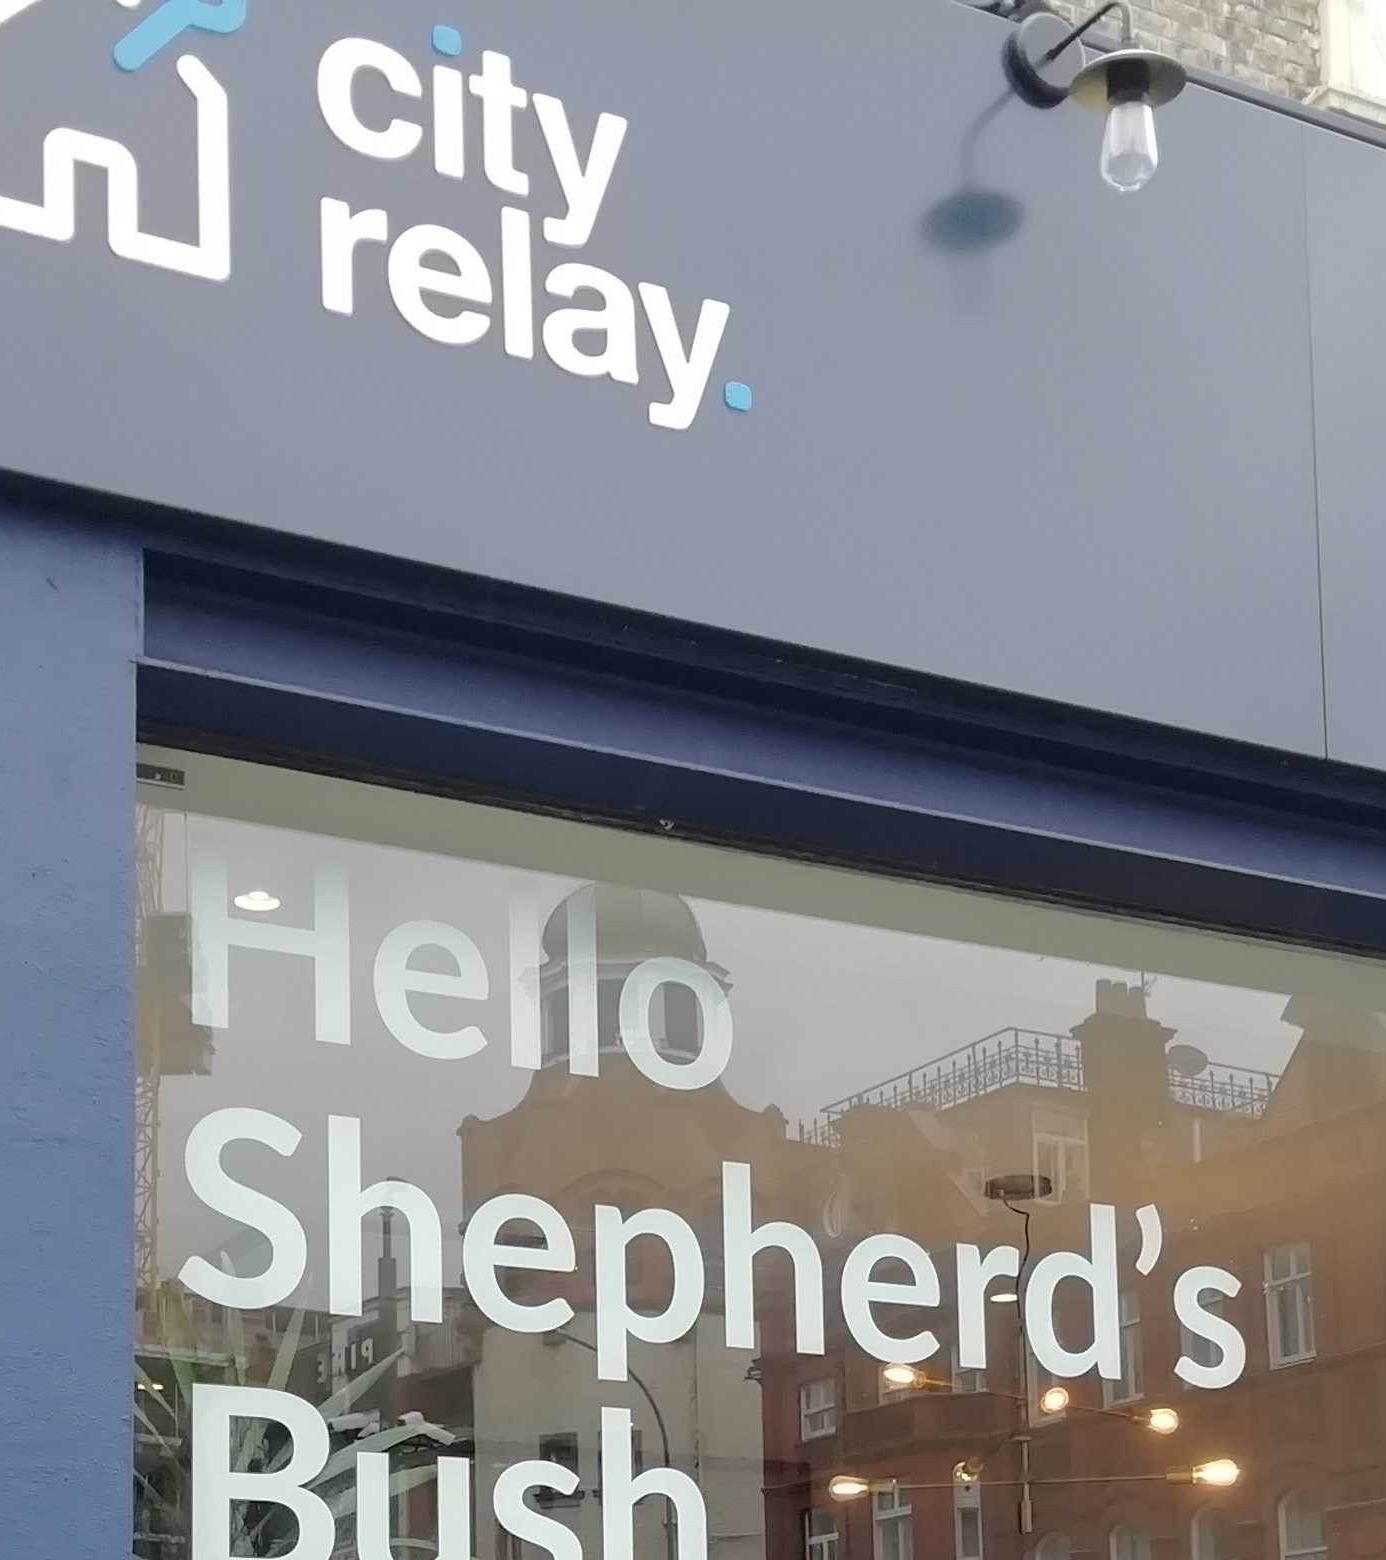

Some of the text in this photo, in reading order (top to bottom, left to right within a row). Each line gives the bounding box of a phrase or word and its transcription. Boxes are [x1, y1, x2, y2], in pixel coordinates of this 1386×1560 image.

[317, 24, 628, 247] city
[320, 195, 752, 430] relay.
[189, 850, 734, 1091] Hello
[177, 1106, 1247, 1390] Shepherd's
